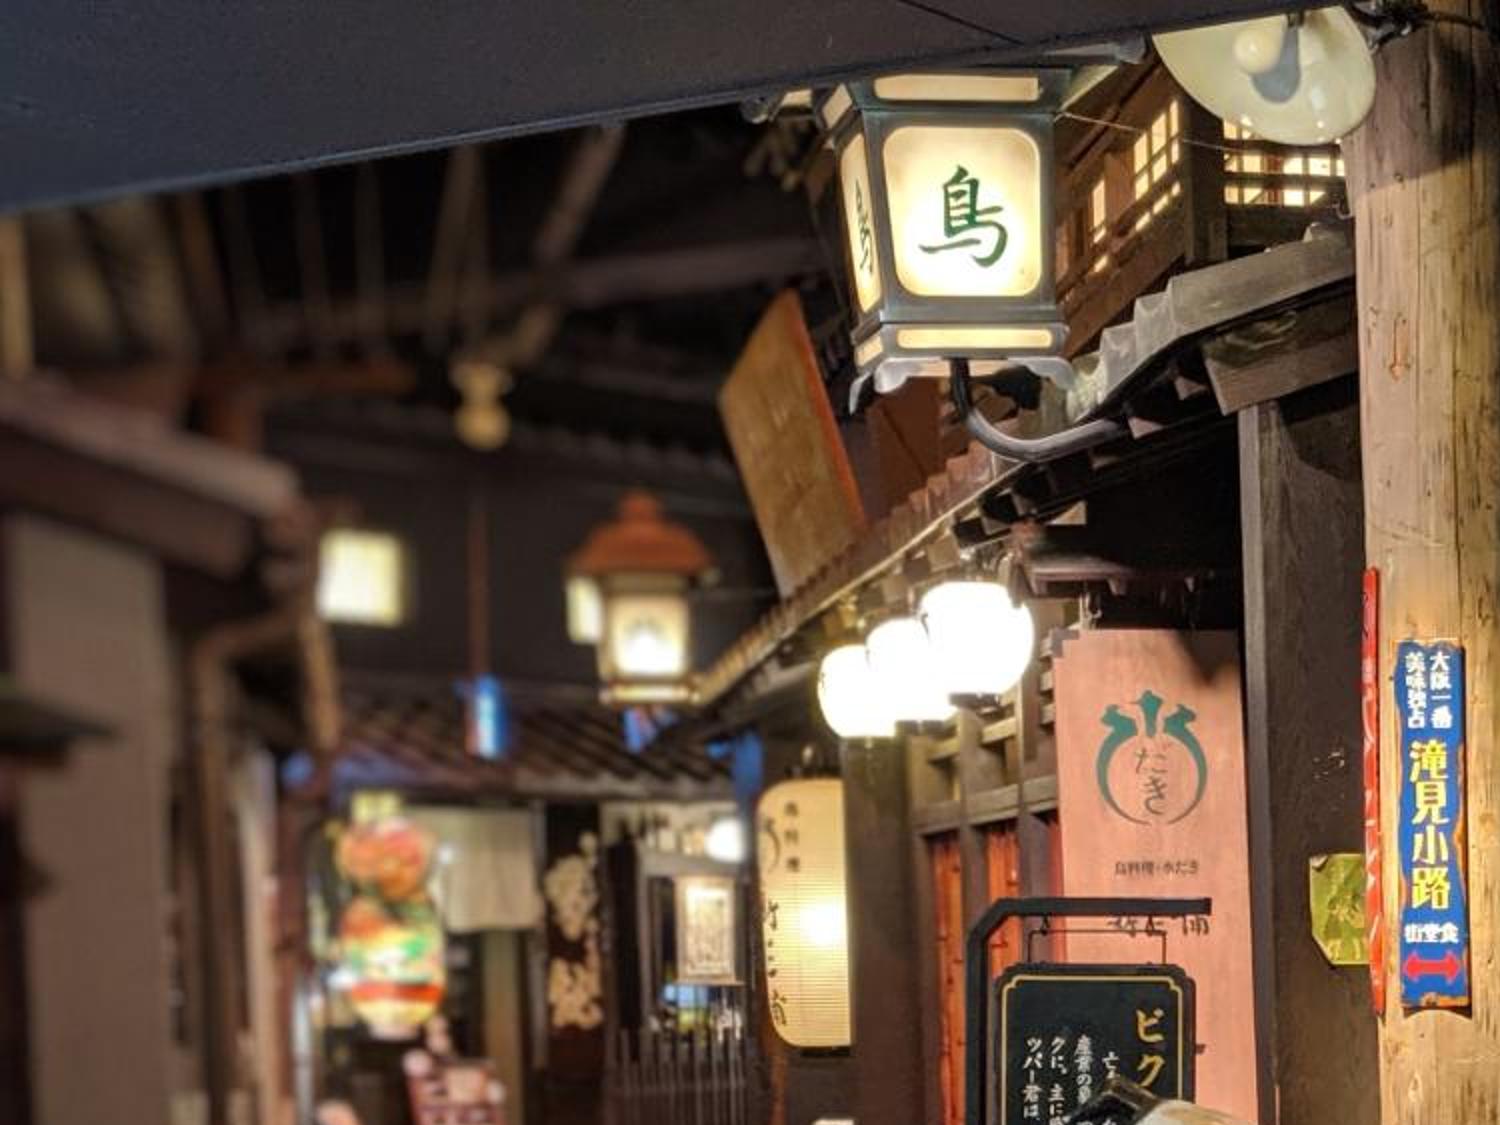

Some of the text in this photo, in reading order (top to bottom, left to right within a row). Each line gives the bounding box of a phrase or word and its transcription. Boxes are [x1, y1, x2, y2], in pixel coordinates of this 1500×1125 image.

[918, 164, 1008, 268] 鳥
[1429, 651, 1454, 729] 大阪一番
[1409, 739, 1452, 910] 滝見小路
